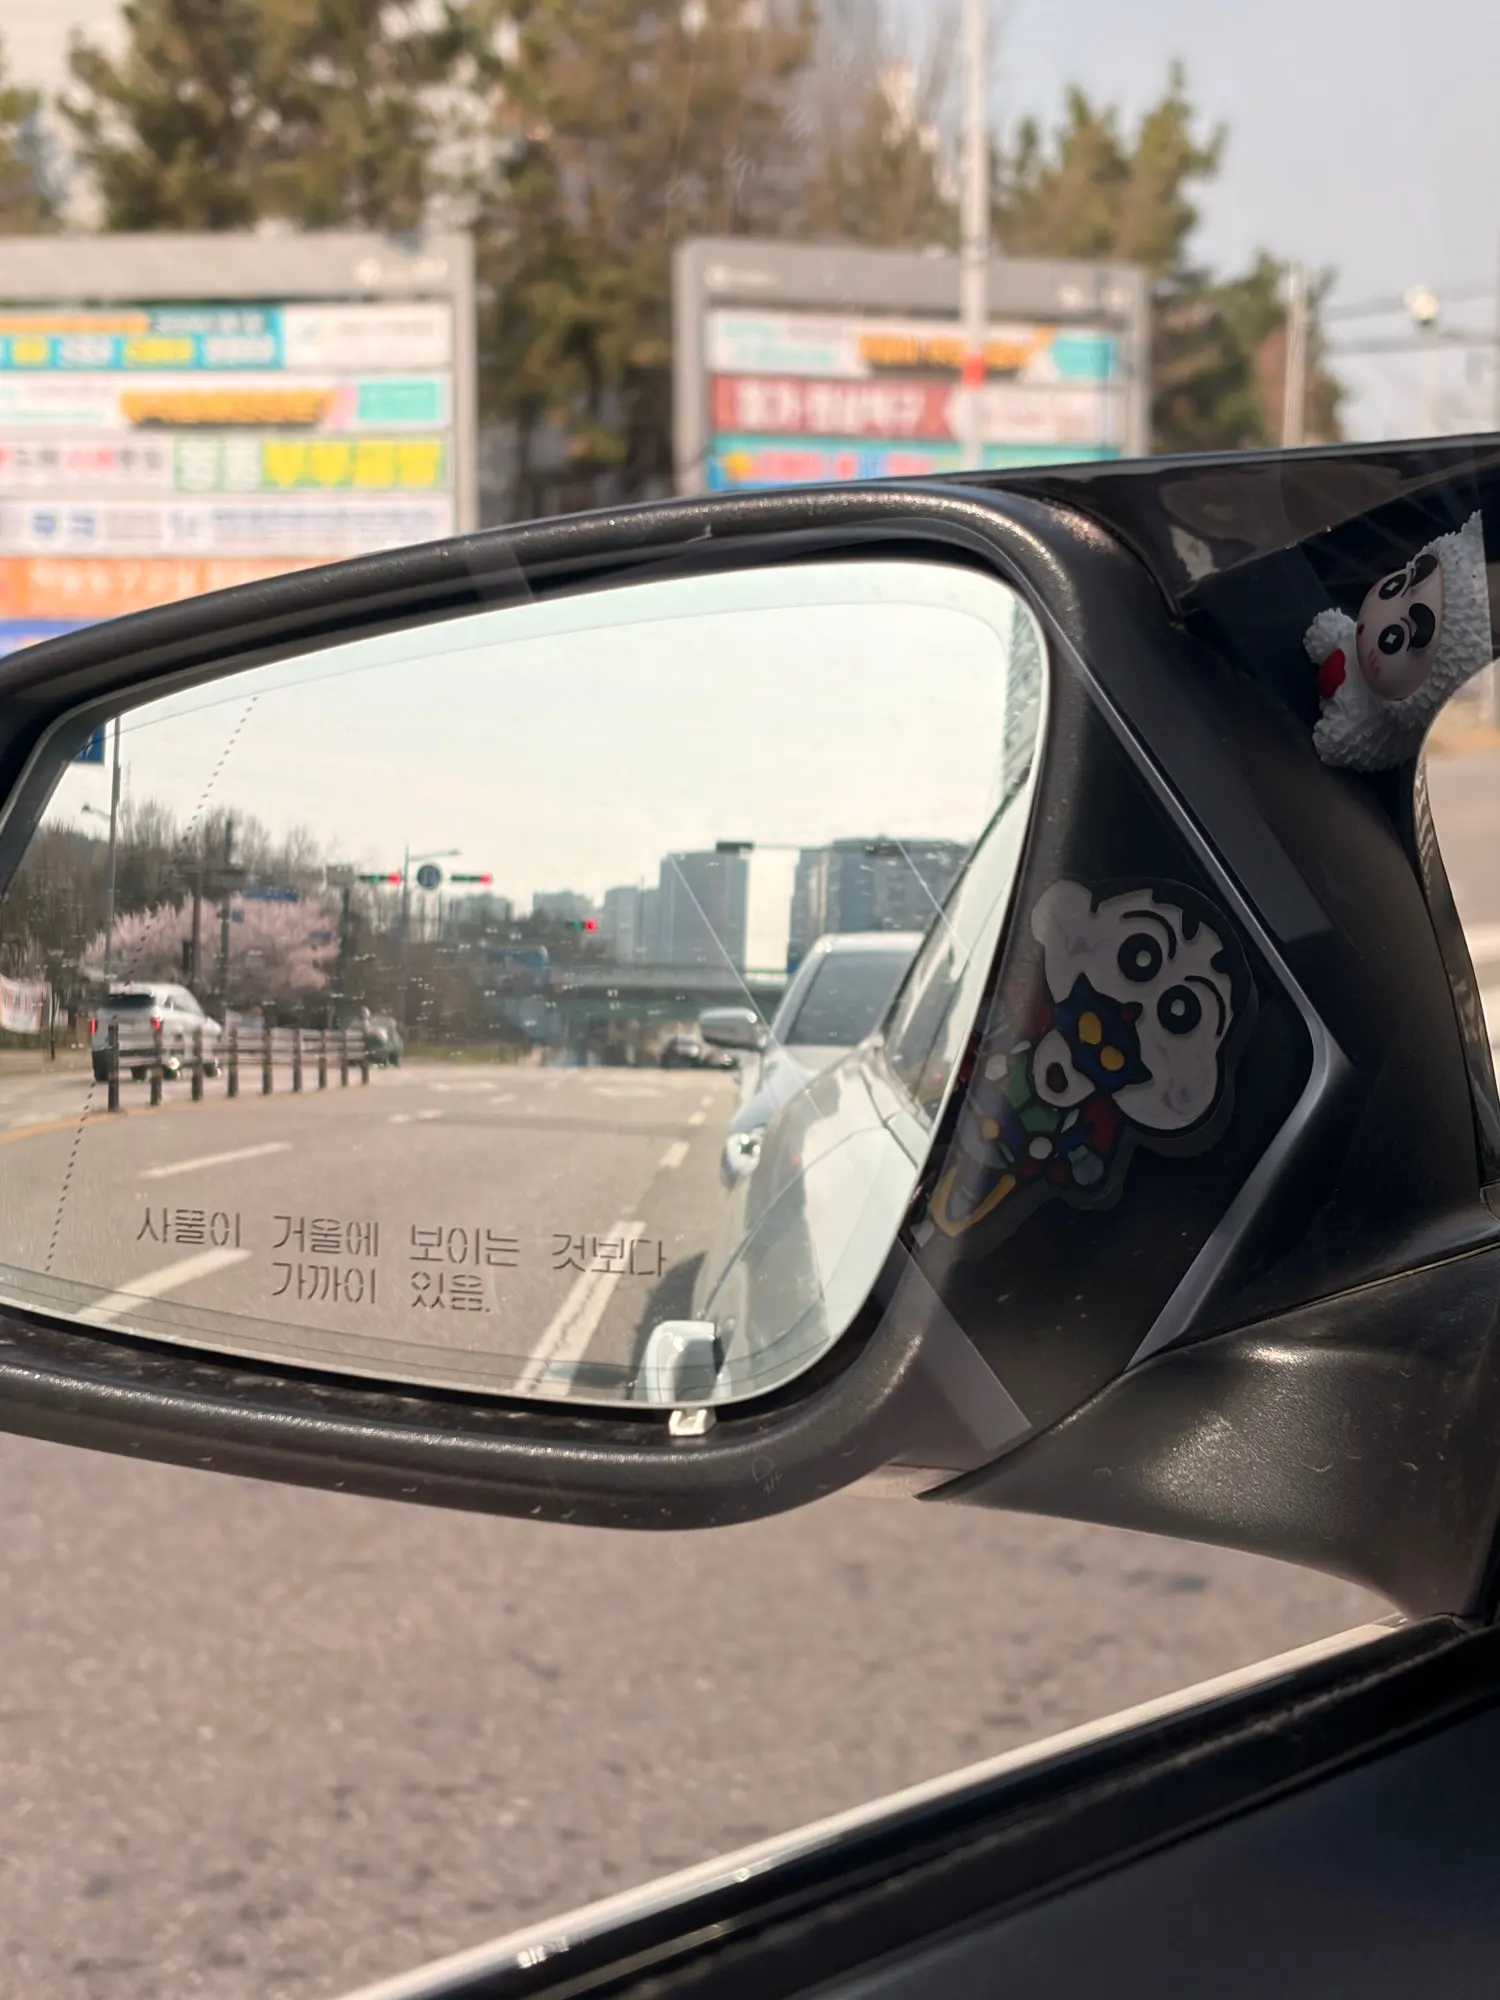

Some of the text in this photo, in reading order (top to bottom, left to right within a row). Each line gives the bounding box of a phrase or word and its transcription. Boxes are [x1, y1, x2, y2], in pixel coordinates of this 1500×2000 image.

[136, 1206, 668, 1278] 사물이 거울에 보이는 것보다
[271, 1261, 377, 1305] 가까이
